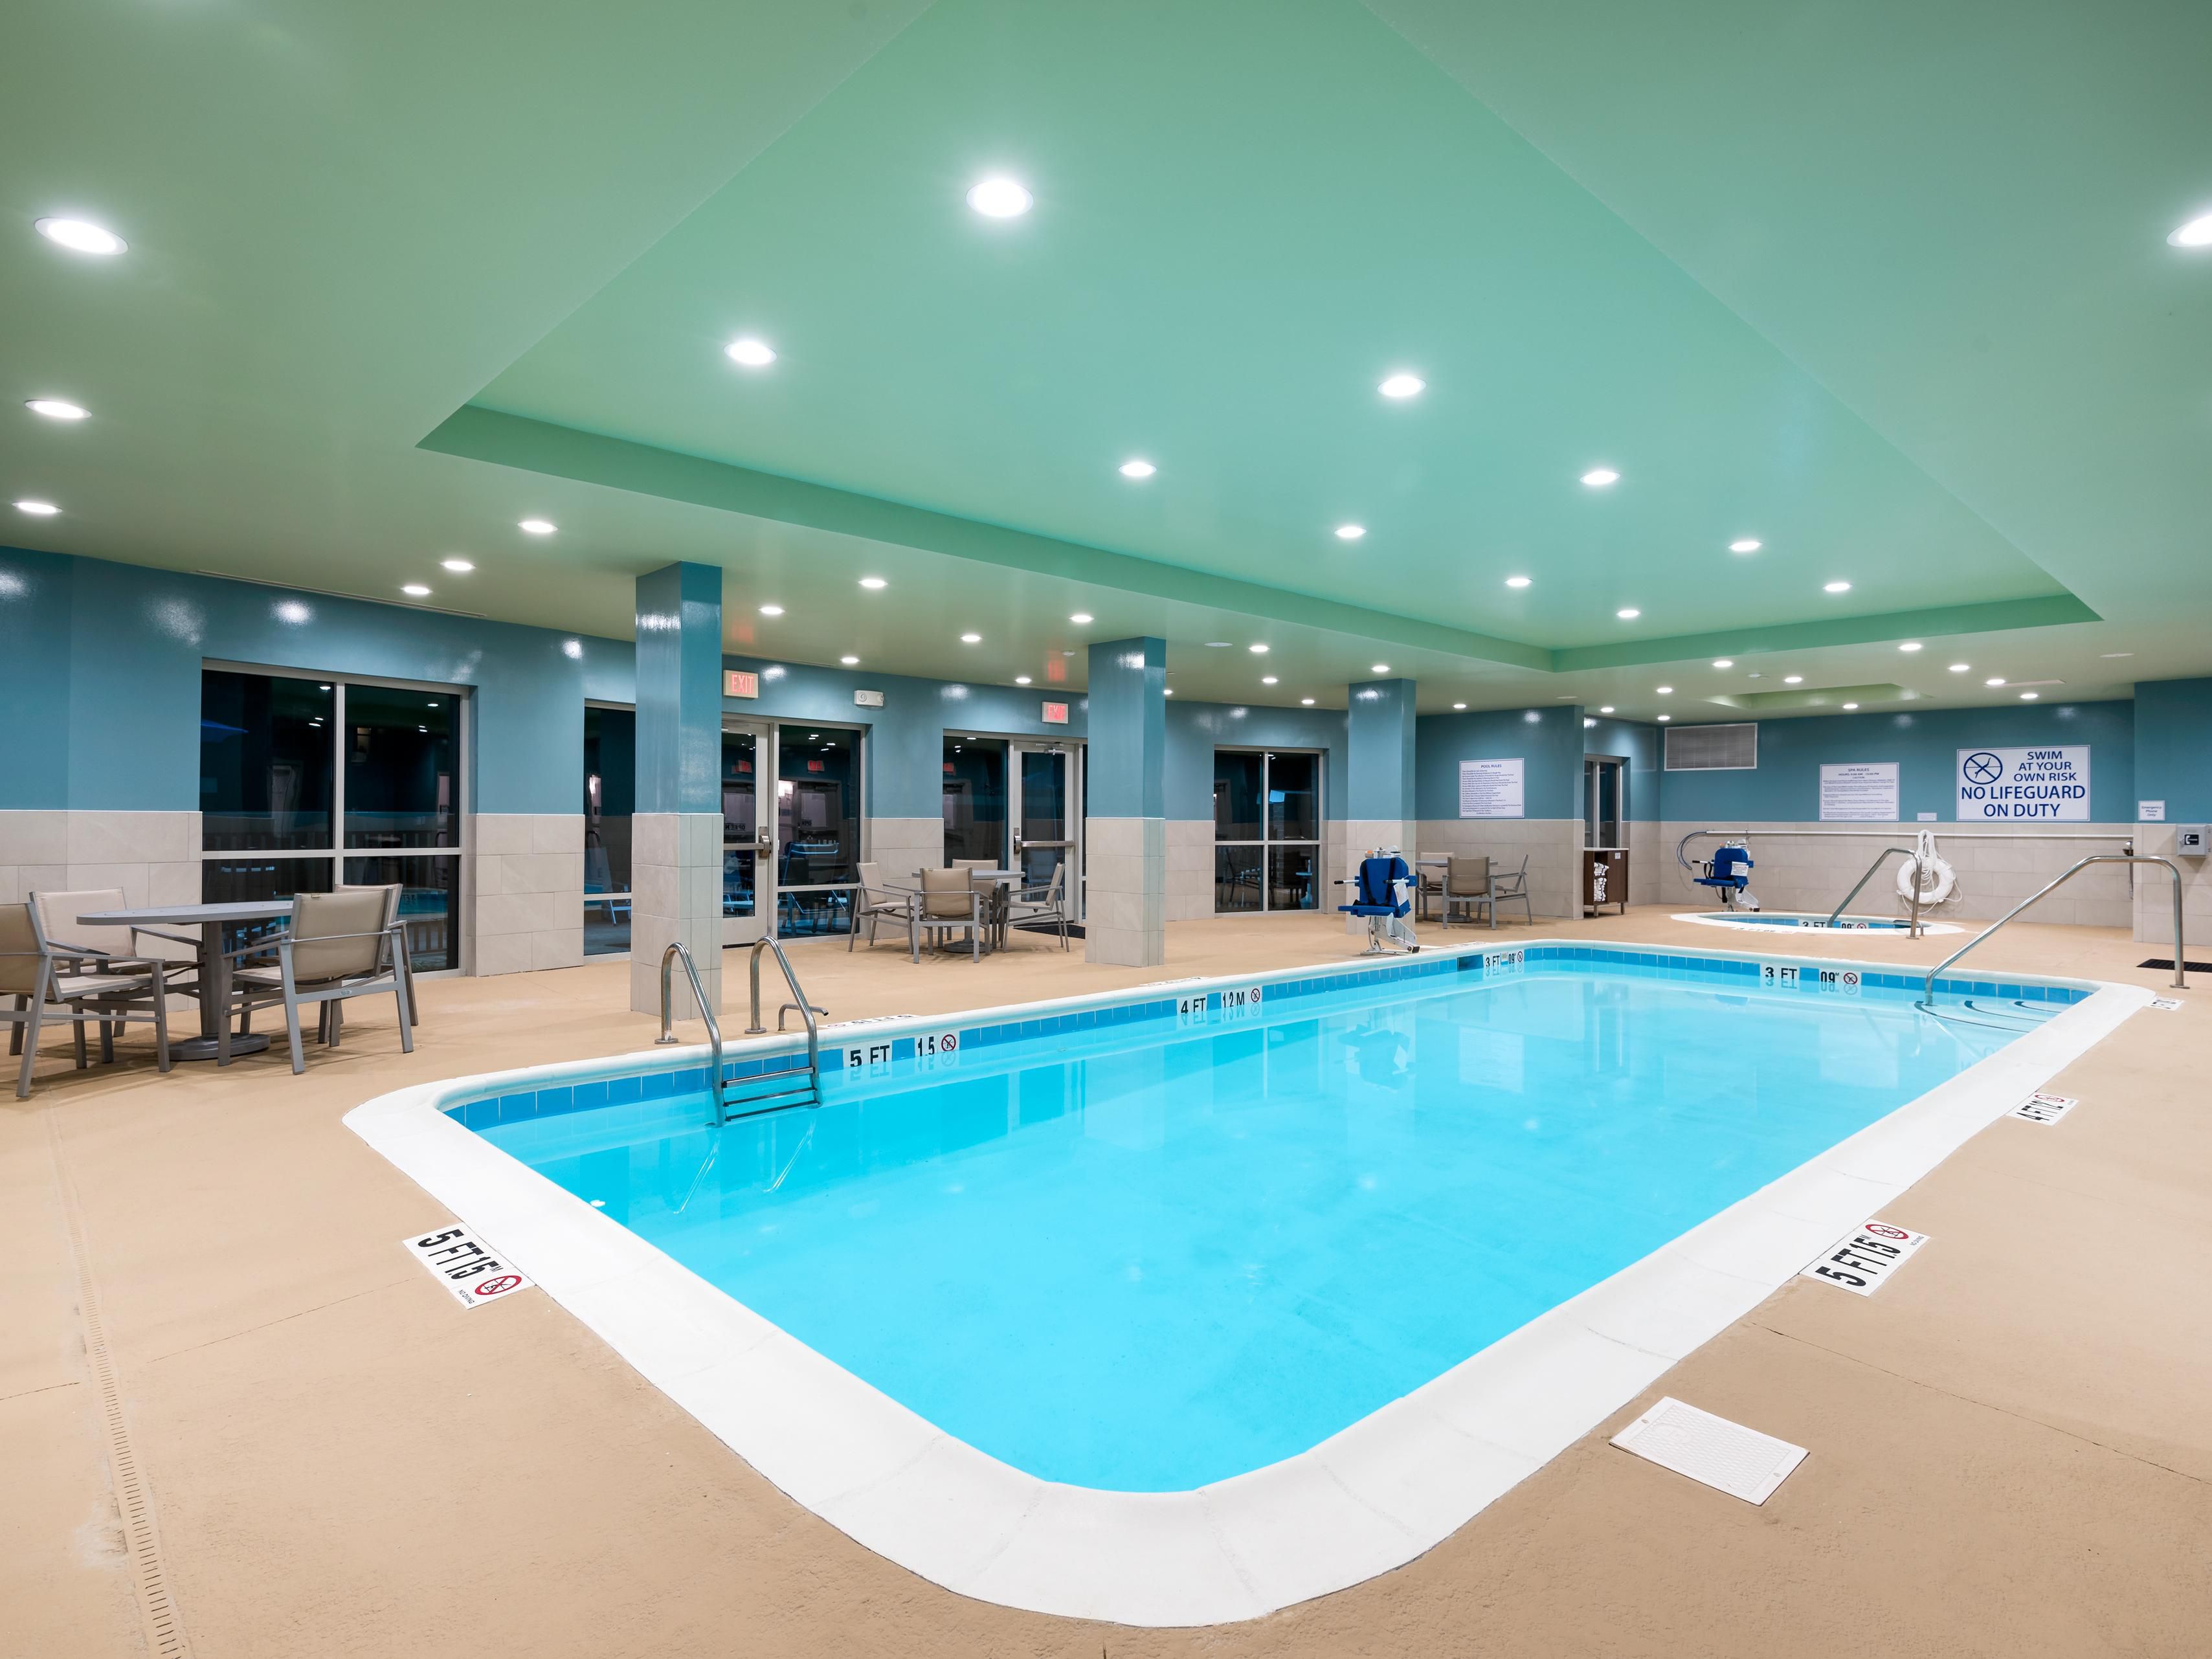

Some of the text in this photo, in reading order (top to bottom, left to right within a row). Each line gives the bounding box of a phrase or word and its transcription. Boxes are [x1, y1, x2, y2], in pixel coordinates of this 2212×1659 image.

[731, 673, 754, 694] EXIT
[1047, 704, 1066, 721] EXIT
[2027, 751, 2062, 761] SWIM
[2018, 761, 2072, 771] AT YOUR
[2013, 772, 2077, 782] OWN RISK
[1961, 785, 2086, 799] NO LIFEGUARD
[1983, 803, 2061, 817] ON DUTY
[1486, 957, 1490, 968] 3
[1492, 955, 1500, 966] FT
[1765, 966, 1774, 977] 3
[1781, 967, 1797, 980] FT
[1180, 1000, 1189, 1014] 4
[1193, 997, 1206, 1012] FT
[849, 1049, 862, 1067] 5
[869, 1045, 890, 1064] FT
[2016, 1111, 2050, 1120] 4
[2020, 1105, 2058, 1118] FT
[418, 1229, 465, 1247] 5
[427, 1241, 484, 1265] FT
[1829, 1247, 1888, 1275] FT
[1815, 1265, 1867, 1287] 5
